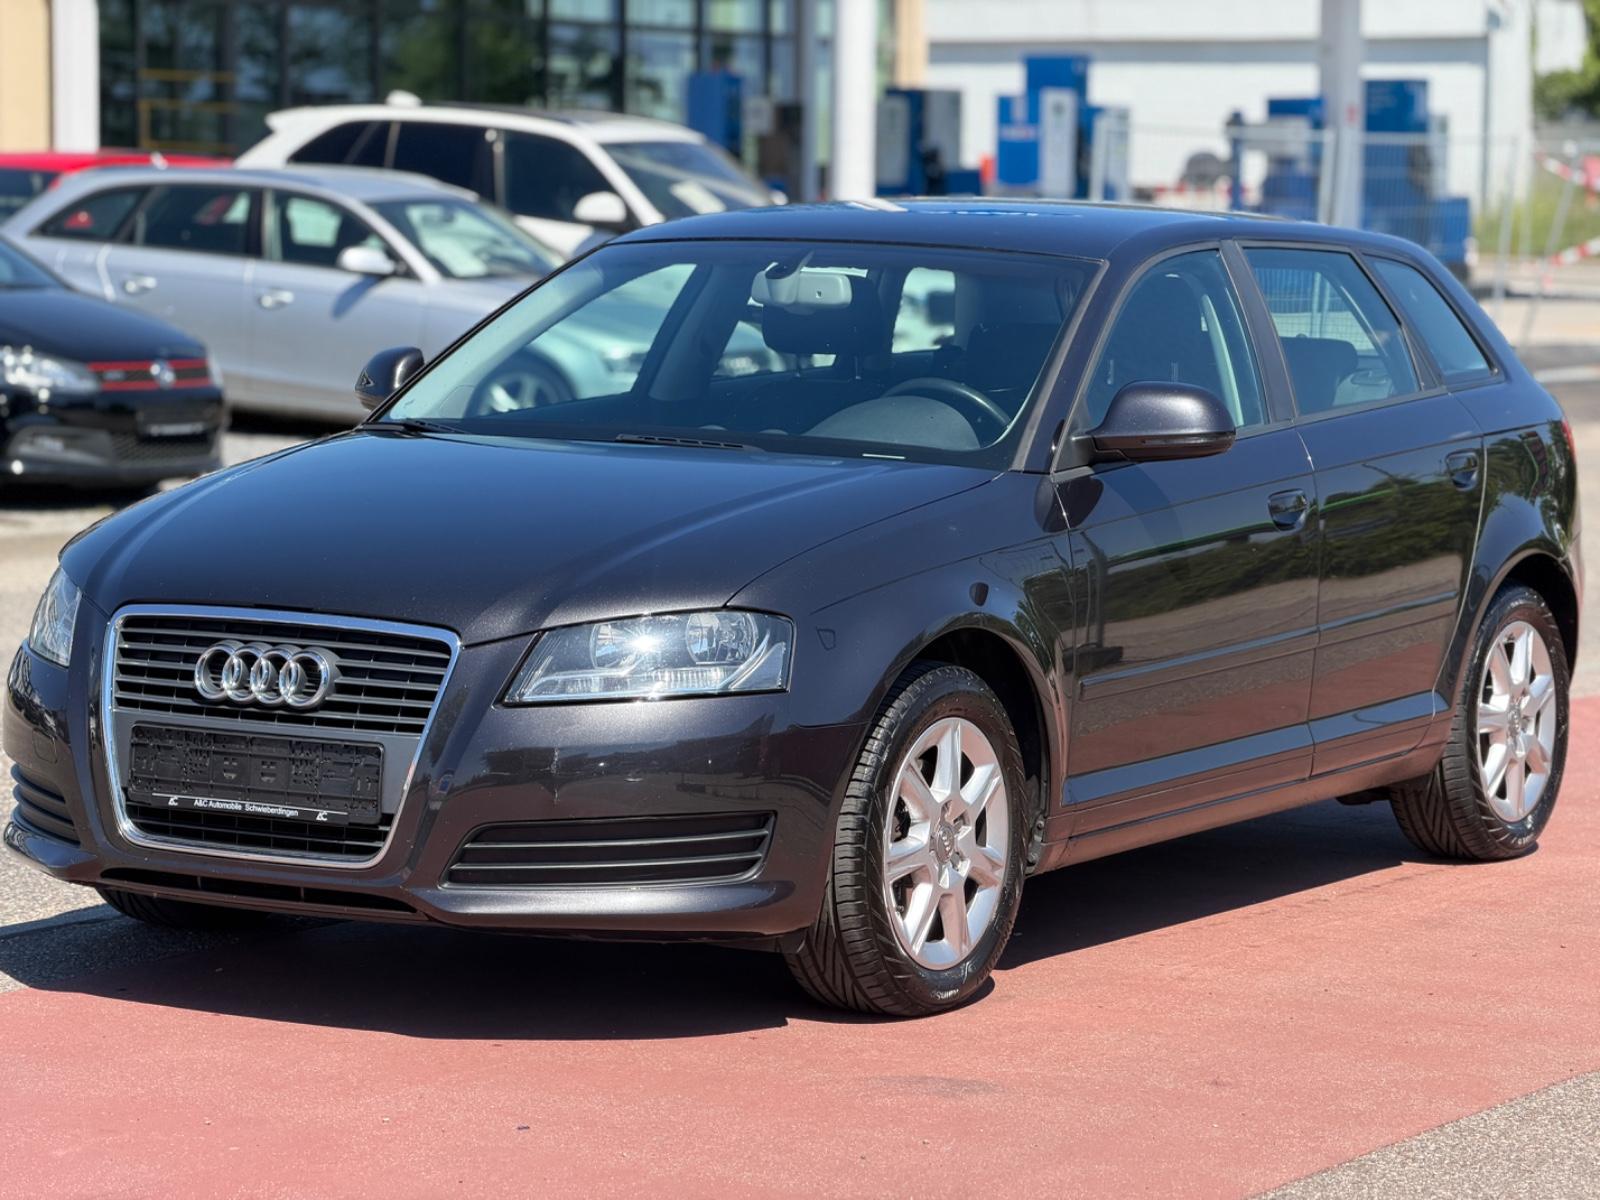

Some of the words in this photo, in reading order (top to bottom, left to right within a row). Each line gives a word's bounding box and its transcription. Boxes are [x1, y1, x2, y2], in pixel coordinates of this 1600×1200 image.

[194, 799, 208, 807] A&C
[209, 801, 242, 810] Automobile
[245, 803, 298, 817] Schwieberdingen
